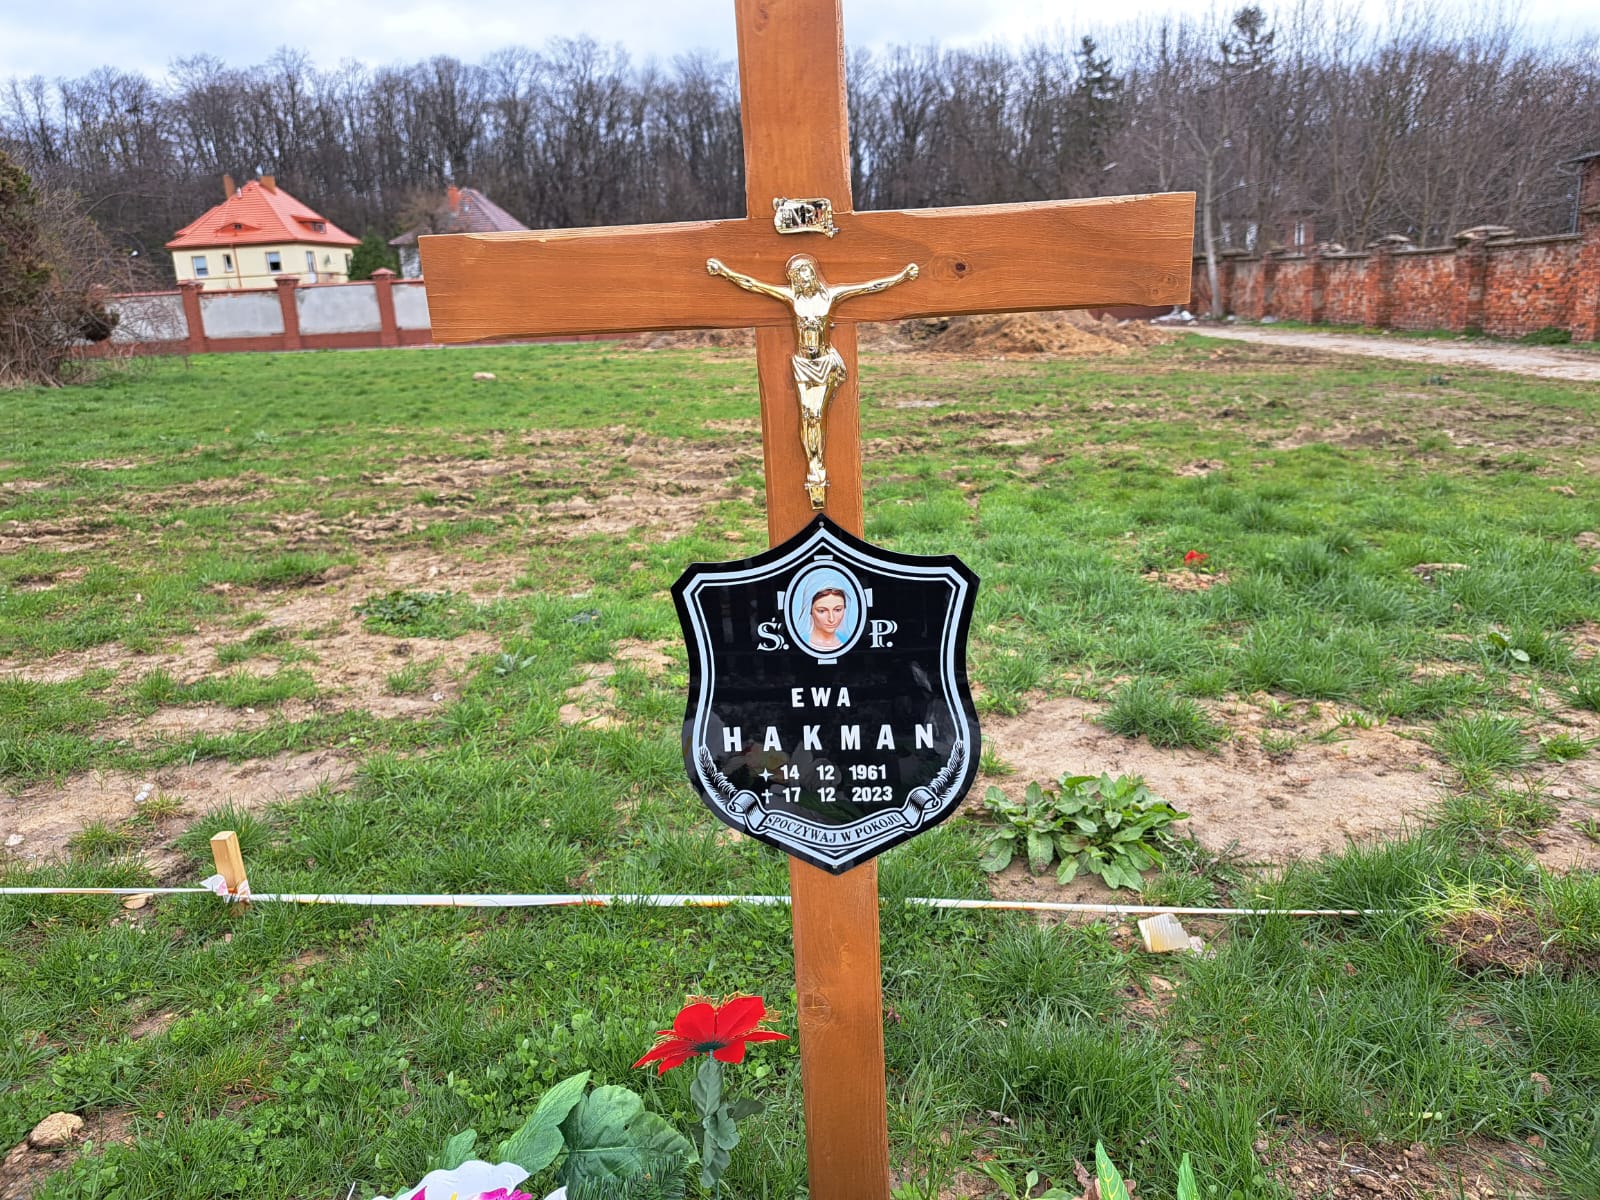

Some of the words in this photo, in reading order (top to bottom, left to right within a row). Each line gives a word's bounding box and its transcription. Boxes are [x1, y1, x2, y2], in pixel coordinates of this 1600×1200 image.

[791, 687, 851, 708] EWA
[723, 723, 934, 752] HAKMAN
[780, 765, 800, 780] 14
[816, 765, 835, 780] 12
[849, 764, 887, 780] 1961
[782, 787, 801, 802] 17
[817, 787, 836, 802] 12
[852, 786, 893, 802] 2023
[766, 815, 837, 843] SPOCZYWAJ
[841, 831, 852, 842] W
[855, 814, 901, 839] POKOJU
